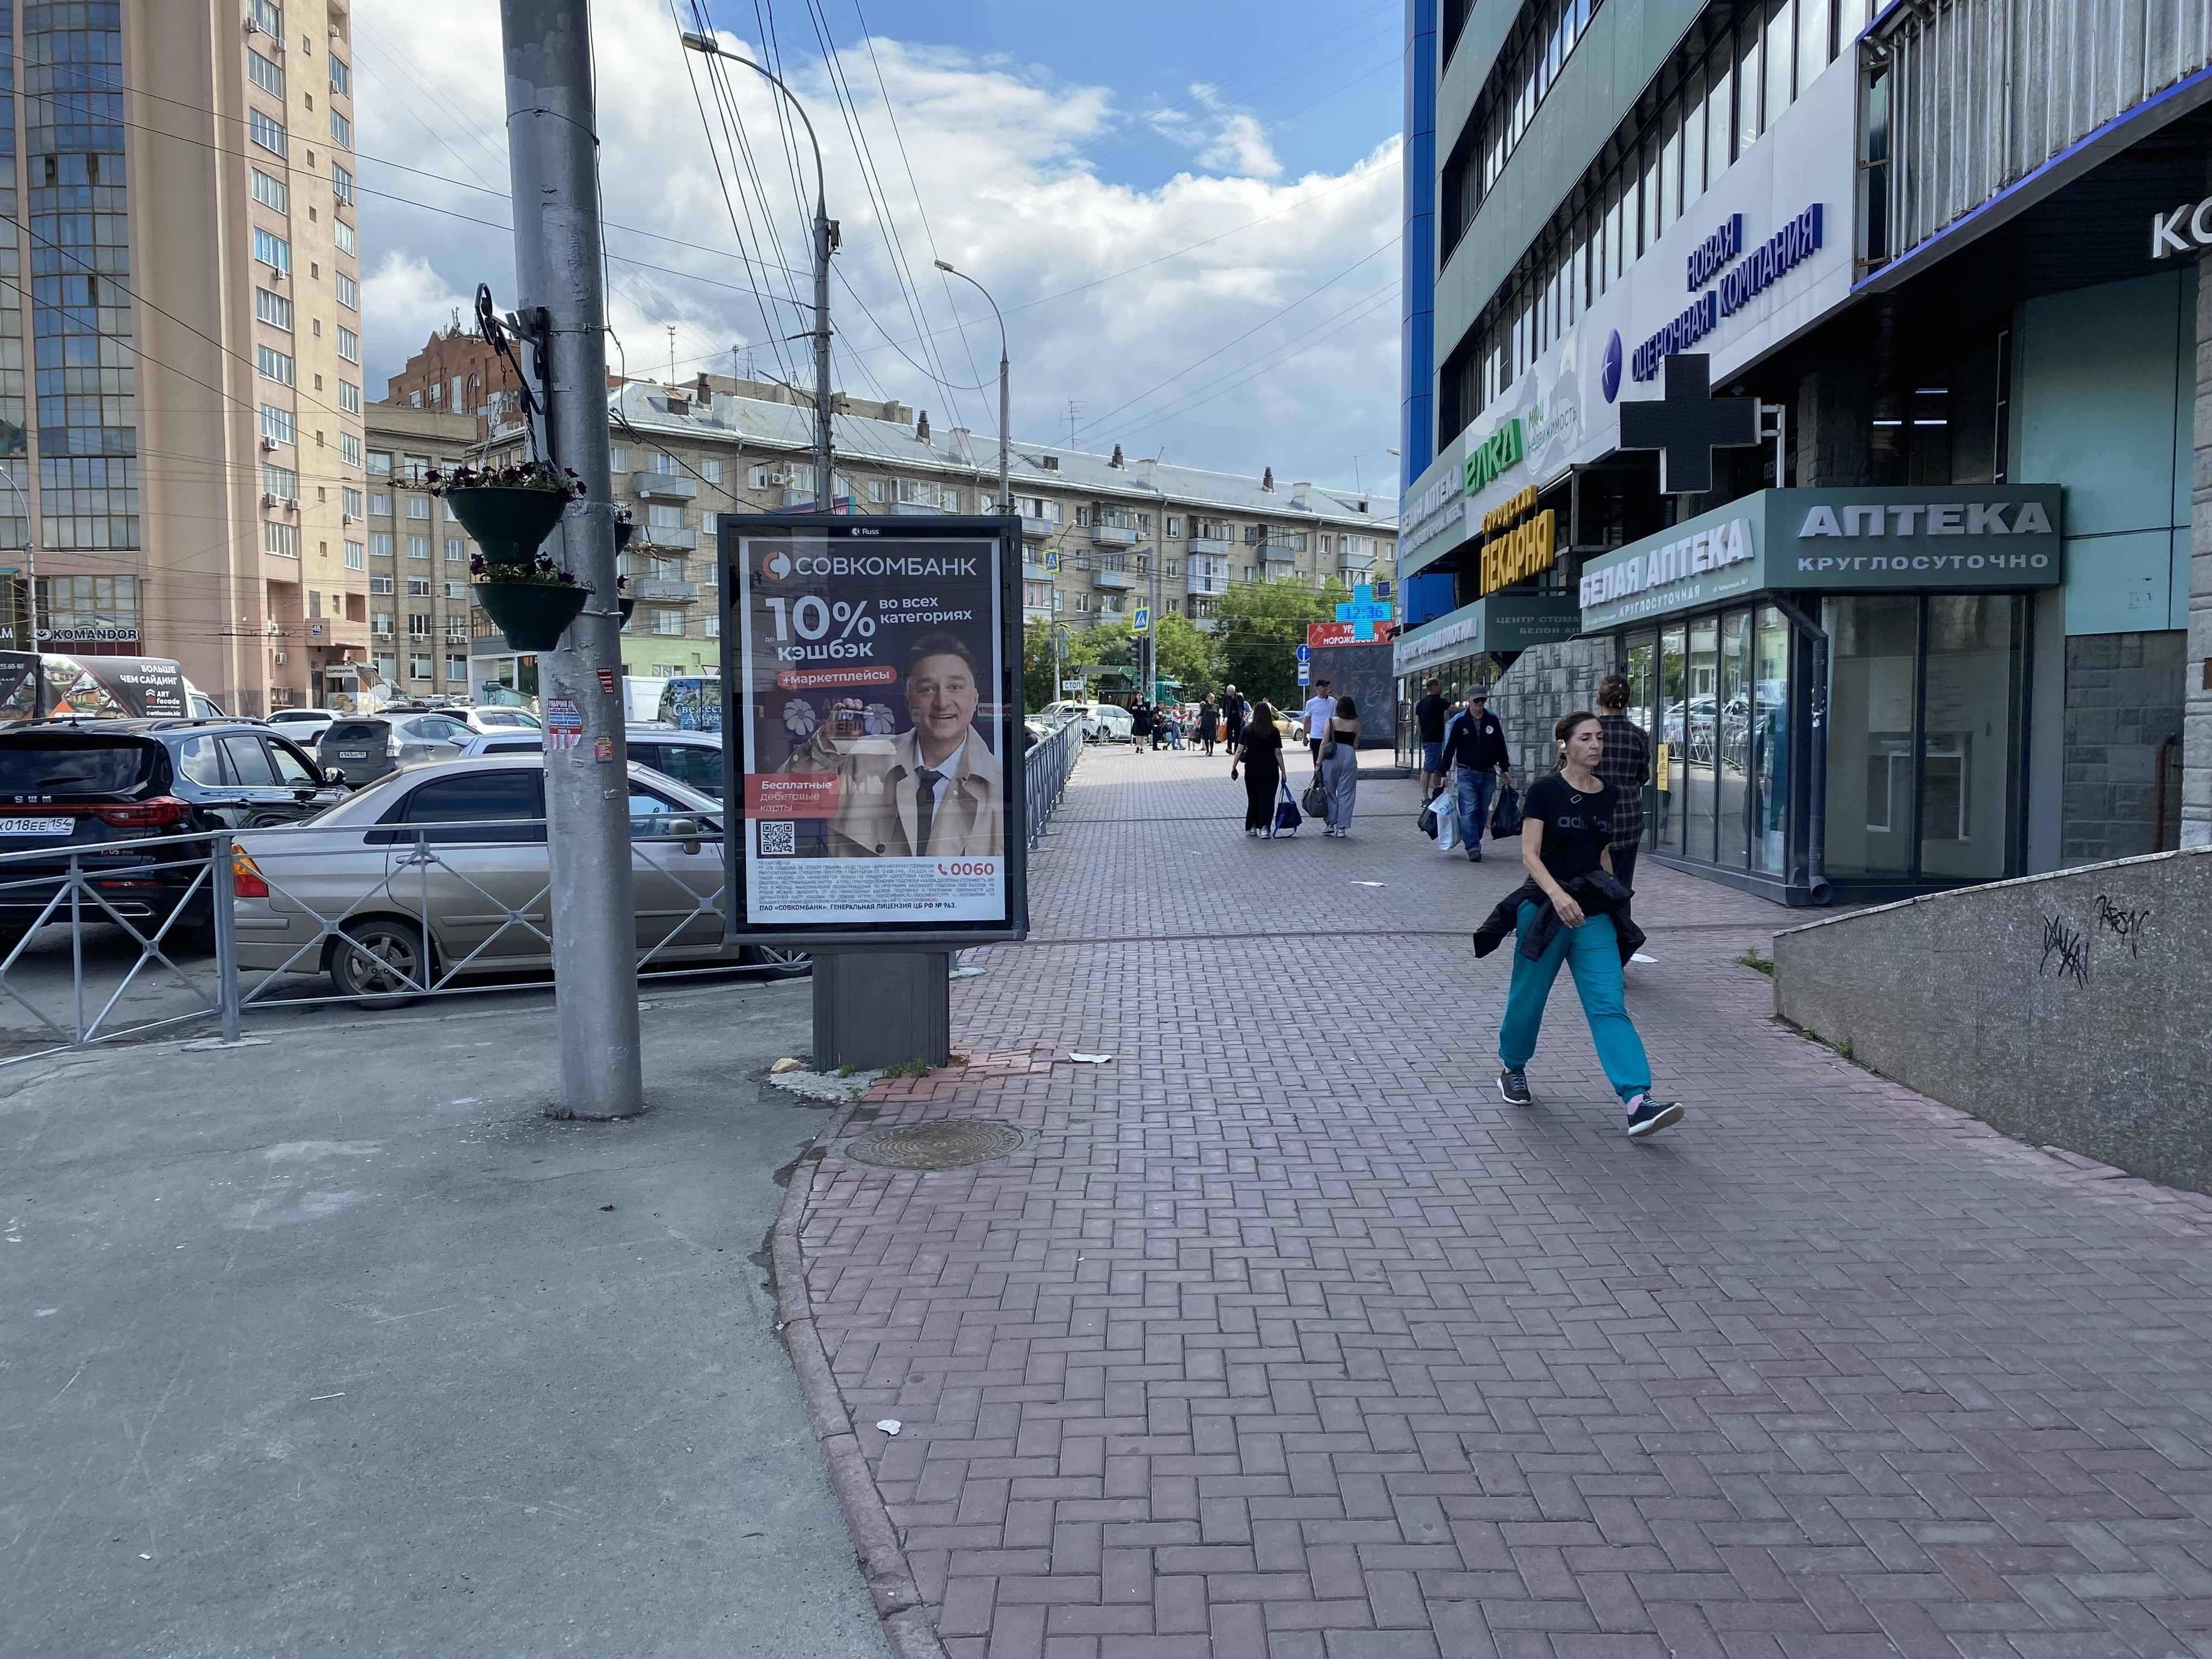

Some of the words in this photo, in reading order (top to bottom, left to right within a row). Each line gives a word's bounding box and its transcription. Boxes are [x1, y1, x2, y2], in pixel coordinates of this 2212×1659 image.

[1687, 213, 1742, 292] НОВАЯ
[1631, 291, 1716, 382] ОЦЕНОЧНАЯ
[1719, 203, 1823, 317] КОМПАНИЯ
[1482, 484, 1539, 534] ГОРОДСКАЯ
[1798, 502, 2052, 537] АПТЕКА
[1480, 509, 1554, 596] ПЕКАРНЯ
[1797, 553, 2049, 571] КРУГЛОСУТОЧНО
[796, 556, 976, 576] СОВКОМБАНК
[1579, 556, 1646, 609] БЕЛАЯ
[1646, 517, 1755, 587] АПТЕКА
[879, 599, 897, 609] во
[903, 596, 938, 608] всех
[1619, 584, 1700, 618] КРУГЛОСУТОЧНАЯ
[765, 596, 876, 641] 10%
[1347, 605, 1382, 619] 12:36
[51, 628, 140, 641] KOMANDOR
[1324, 632, 1379, 645] МОРОЖЕ!!
[778, 639, 873, 661] кэшбэк
[141, 665, 176, 673] БОЛЬШЕ
[783, 669, 890, 685] +маркетплейсы
[120, 675, 138, 683] ЧЕМ
[139, 675, 177, 685] САЙДИНГ
[762, 781, 832, 789] Бесплатные
[760, 792, 820, 801] дебетовые
[1558, 813, 1613, 834] adas
[951, 863, 994, 876] 0060
